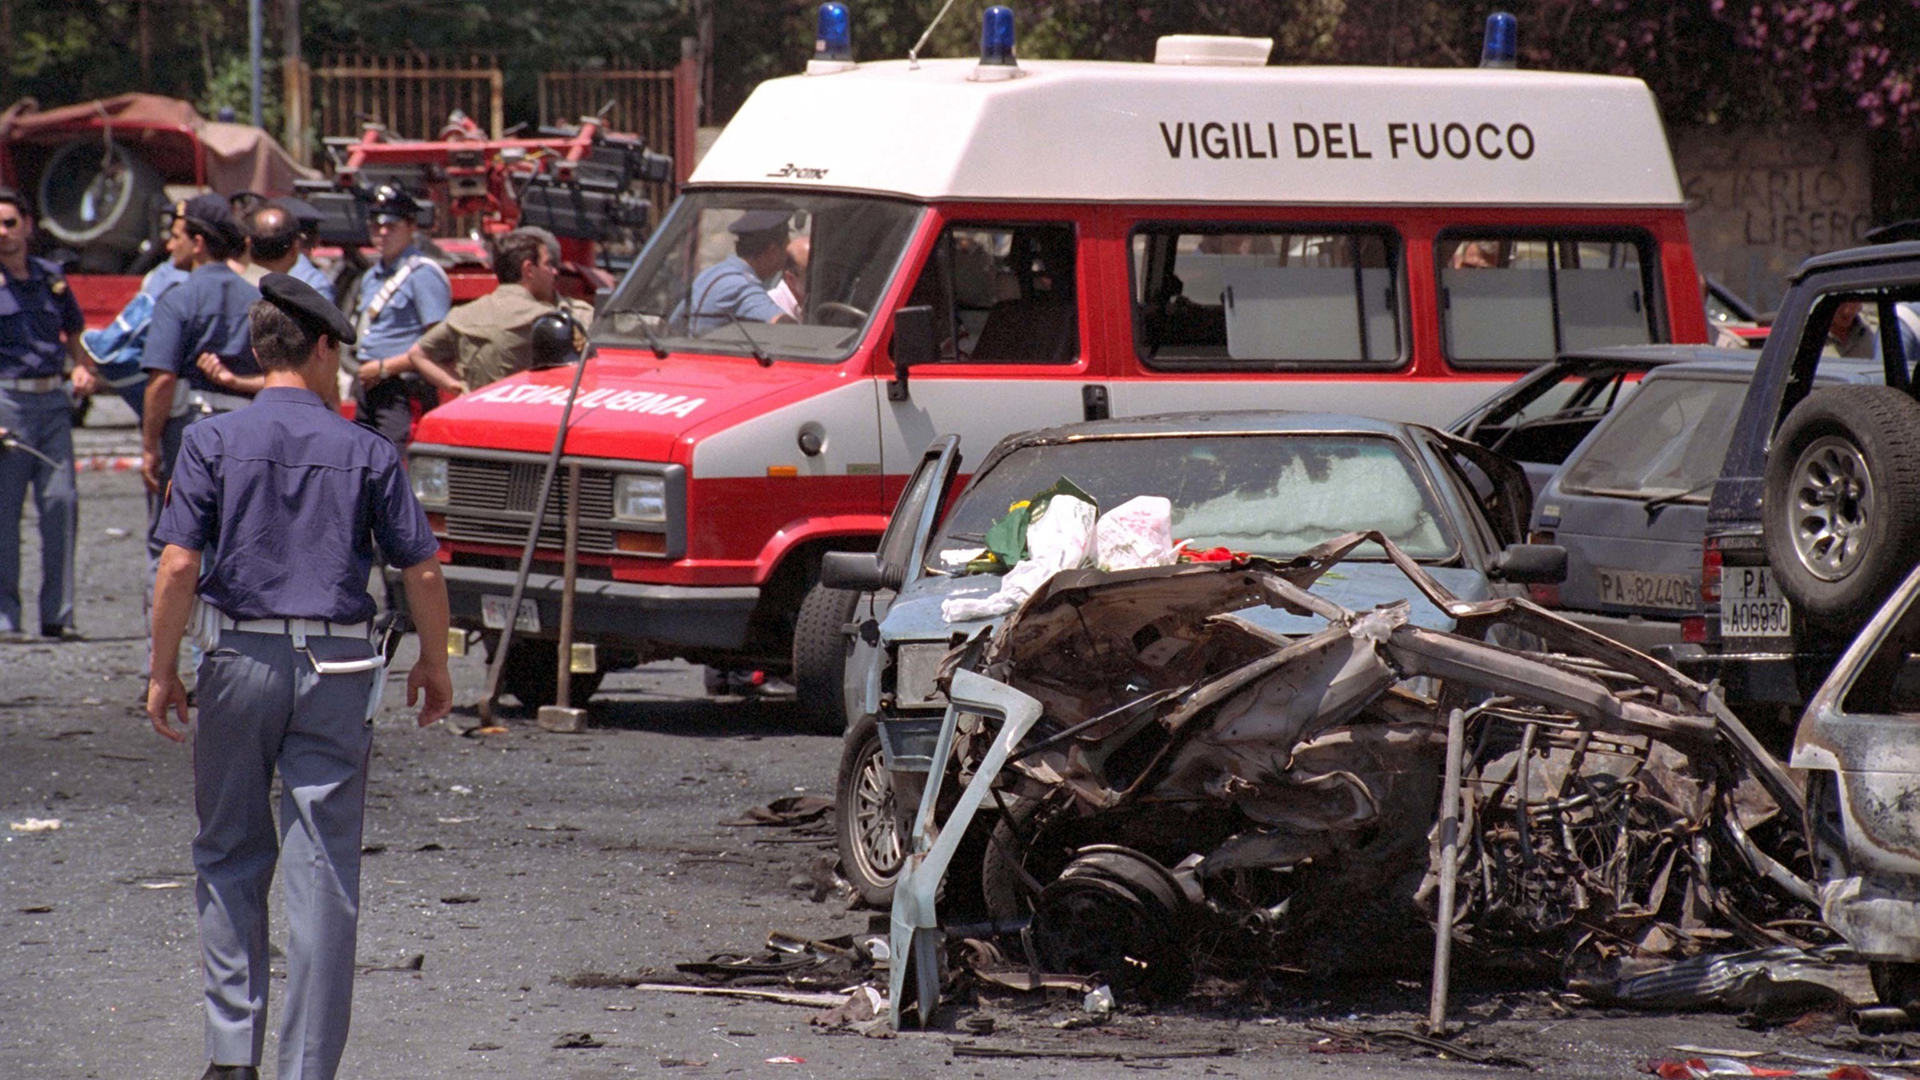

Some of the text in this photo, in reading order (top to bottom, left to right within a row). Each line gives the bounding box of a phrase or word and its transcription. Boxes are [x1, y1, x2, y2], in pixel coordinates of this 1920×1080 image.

[1159, 121, 1536, 160] VIGILI DEL FUOCO
[1743, 570, 1767, 598] PA
[1731, 603, 1788, 632] A06930
